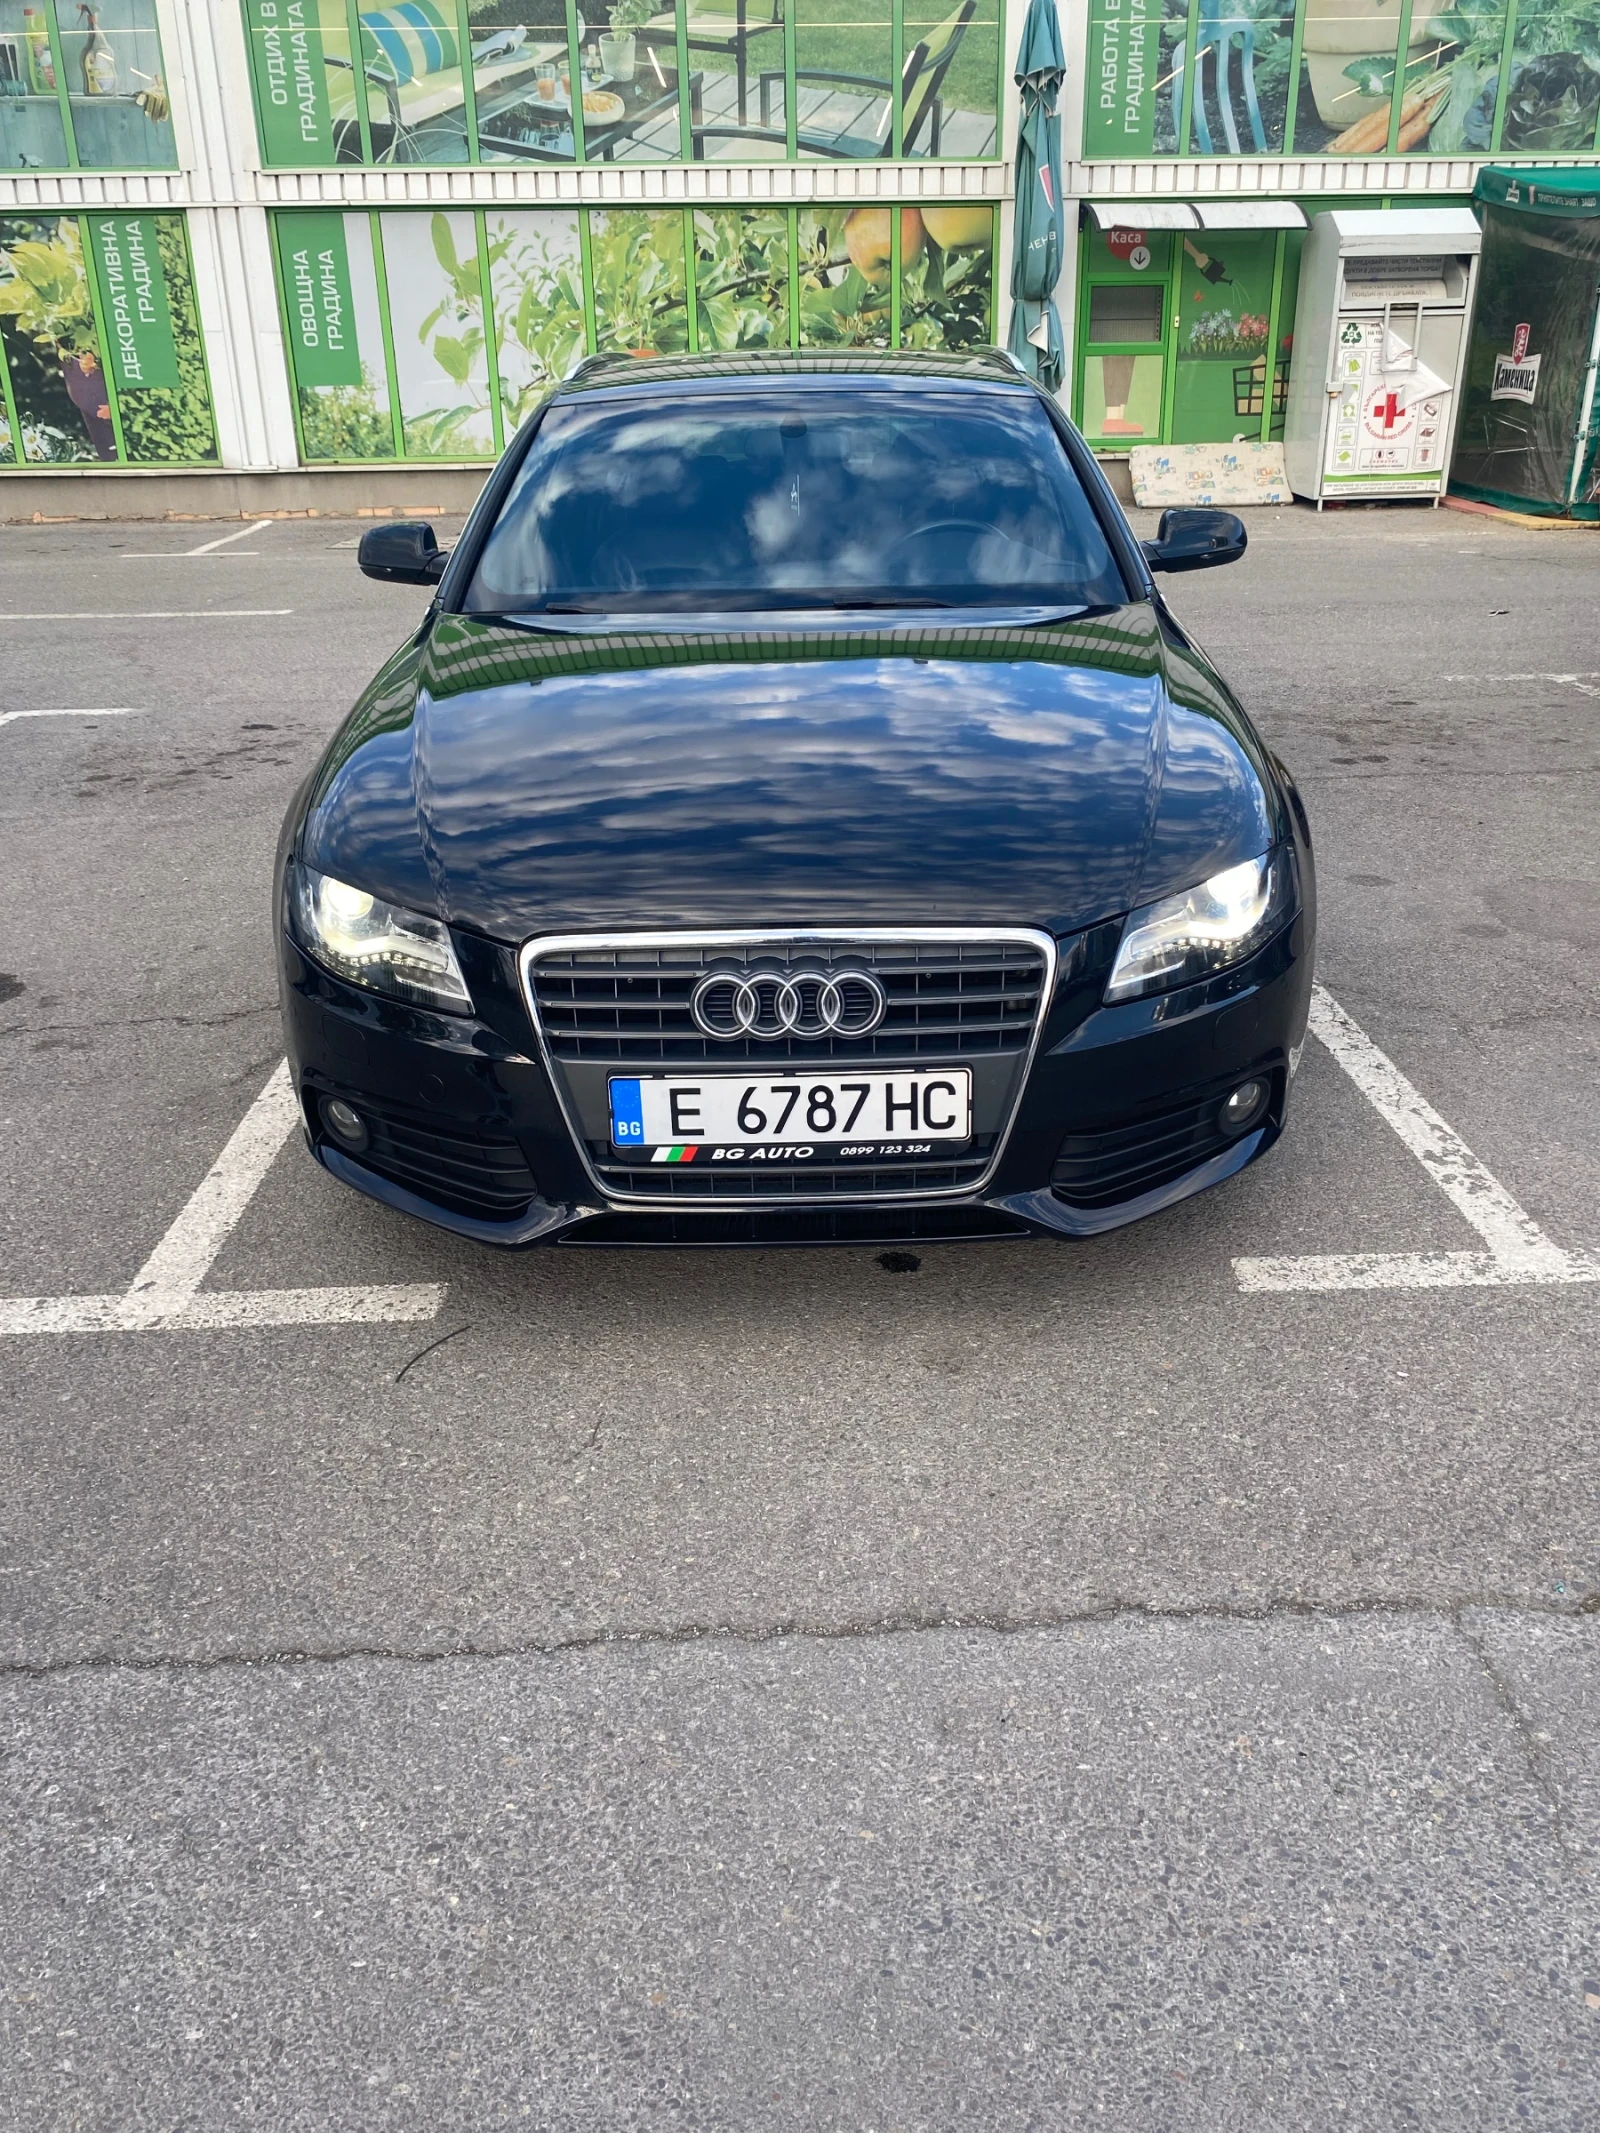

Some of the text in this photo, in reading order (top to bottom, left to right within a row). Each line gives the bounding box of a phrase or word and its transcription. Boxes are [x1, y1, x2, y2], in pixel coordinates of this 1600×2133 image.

[260, 1, 288, 105] ОТДИХ В
[287, 1, 319, 142] ГРАДИНАТА
[1100, 17, 1120, 108] РАБОТА
[125, 220, 156, 323] ГРАДИНА
[1110, 231, 1142, 244] Каса
[100, 220, 143, 381] ДЕКОРАТИВНА
[292, 249, 319, 347] ОВОЩНА
[318, 249, 344, 350] ГРАДИНА
[1493, 363, 1536, 394] Каменица
[618, 1121, 641, 1136] BG
[669, 1080, 956, 1136] E 6787 HC
[711, 1144, 932, 1160] BG AUTO 0899 123 324
